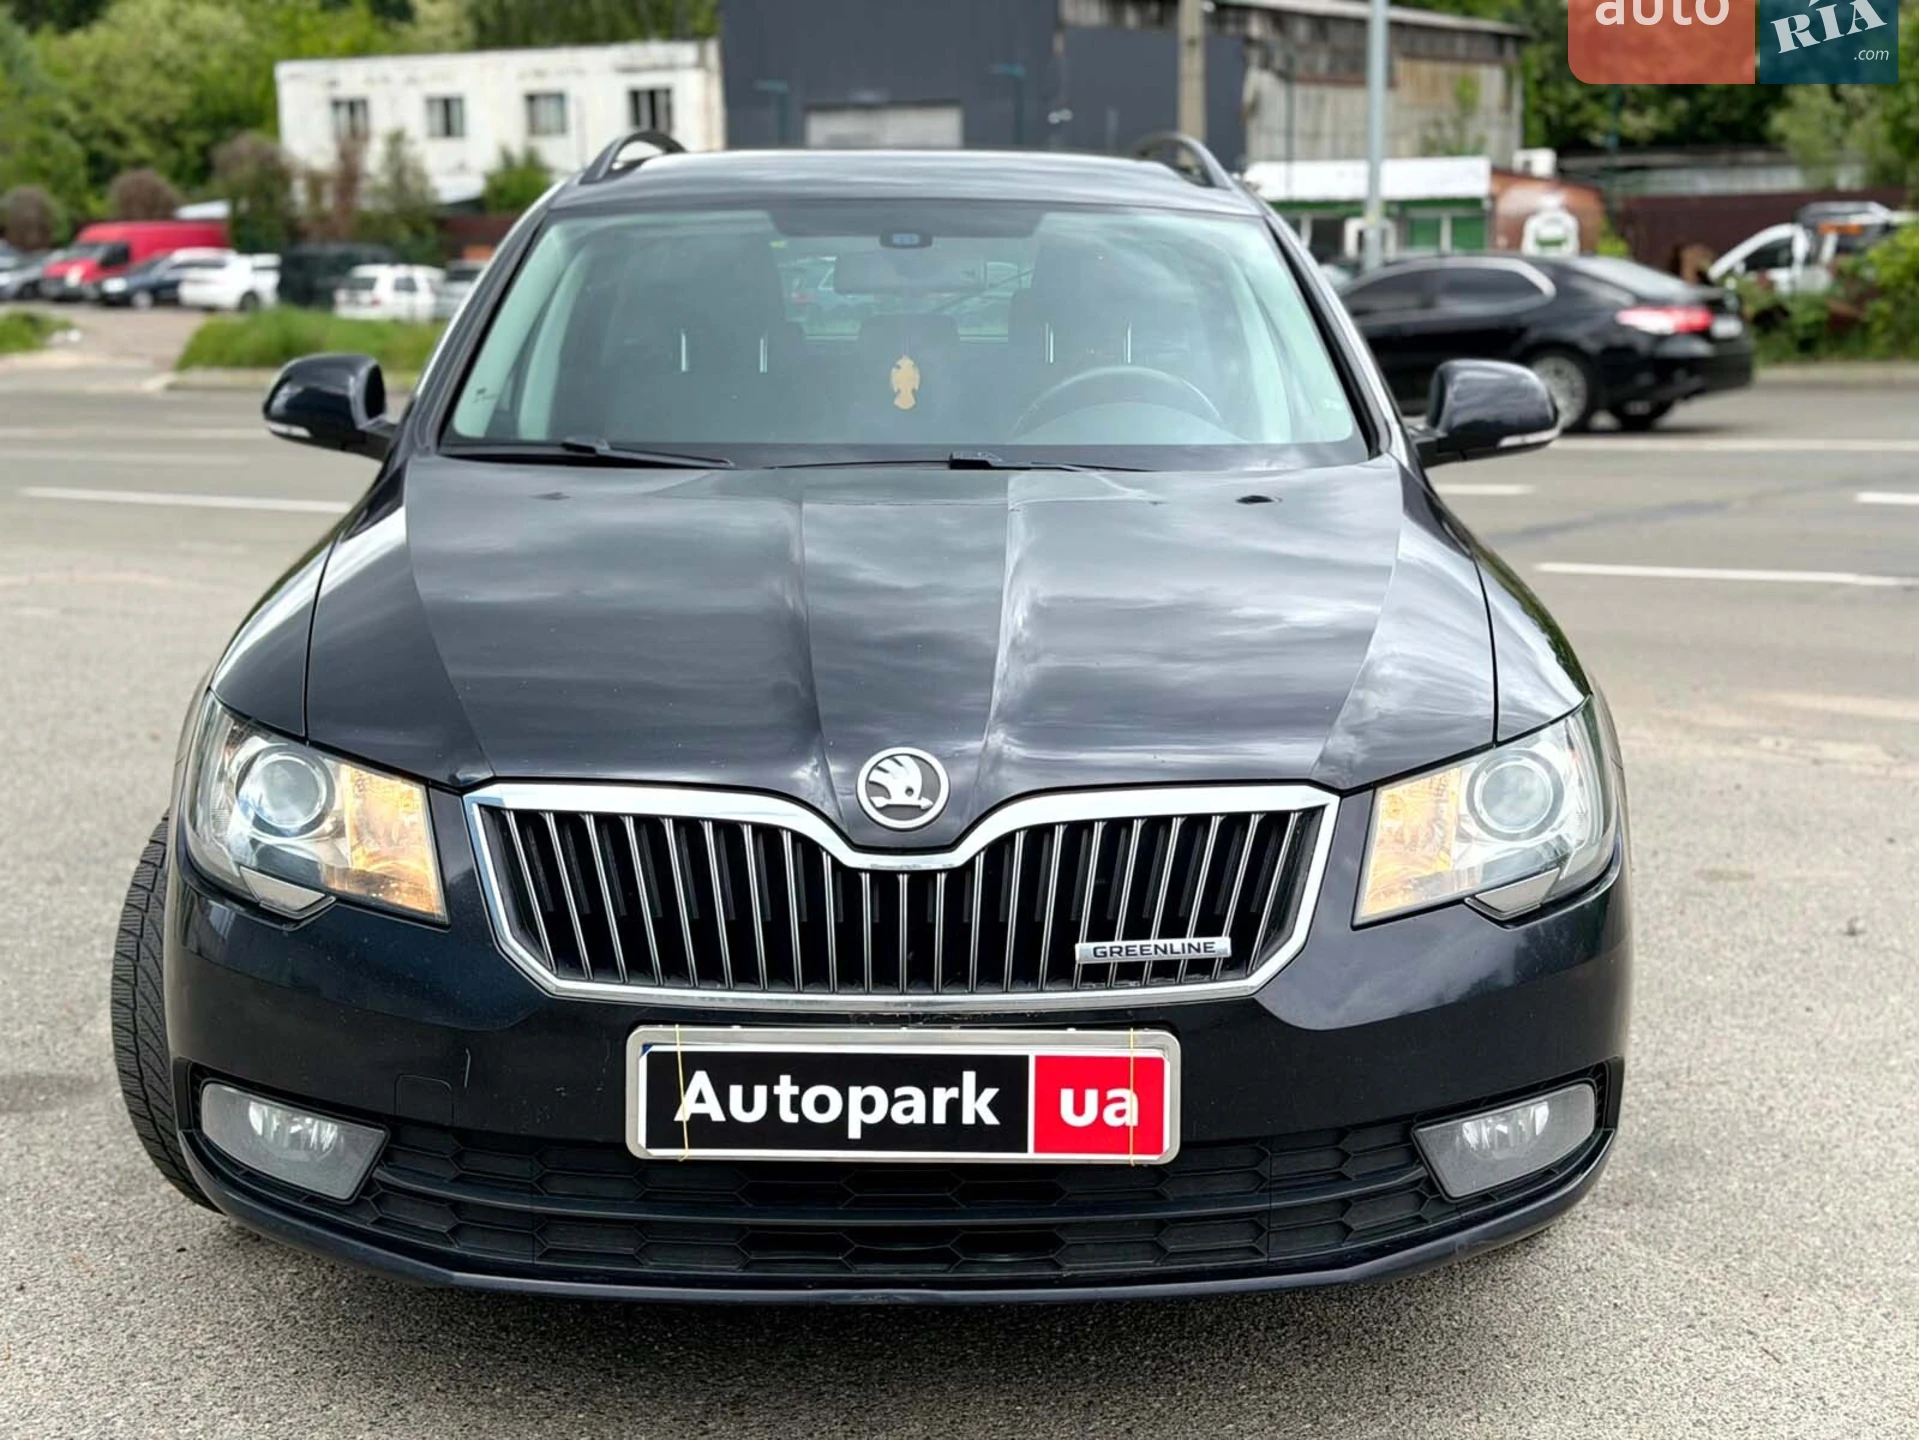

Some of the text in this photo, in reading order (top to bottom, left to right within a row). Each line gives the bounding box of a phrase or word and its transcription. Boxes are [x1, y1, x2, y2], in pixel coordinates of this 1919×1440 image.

[1093, 941, 1216, 958] GREENLINE
[674, 1070, 1139, 1139] Autopark ua
